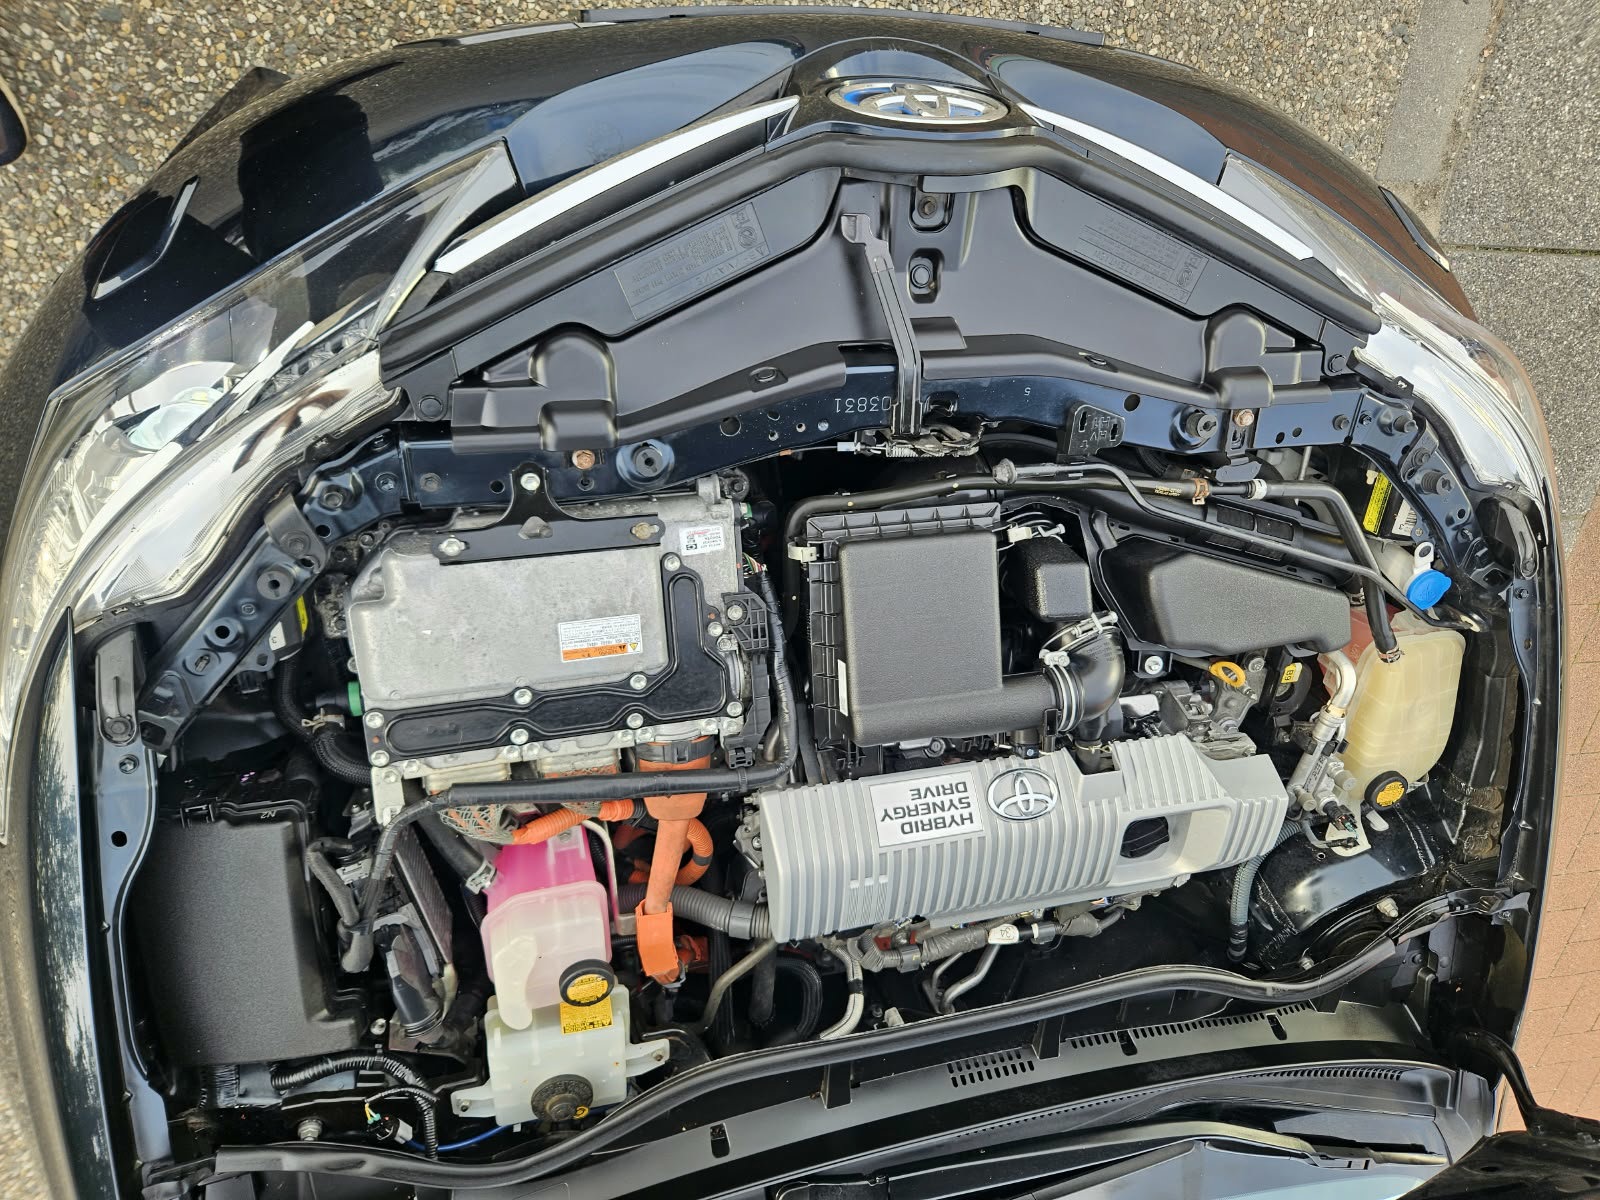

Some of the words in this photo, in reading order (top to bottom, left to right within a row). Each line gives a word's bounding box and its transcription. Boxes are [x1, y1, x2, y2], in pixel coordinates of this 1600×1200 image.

[1023, 387, 1031, 396] 5
[834, 396, 891, 413] 03831
[909, 781, 968, 801] DRIVE
[880, 795, 971, 822] SYNERGY
[900, 812, 974, 835] HYBRID
